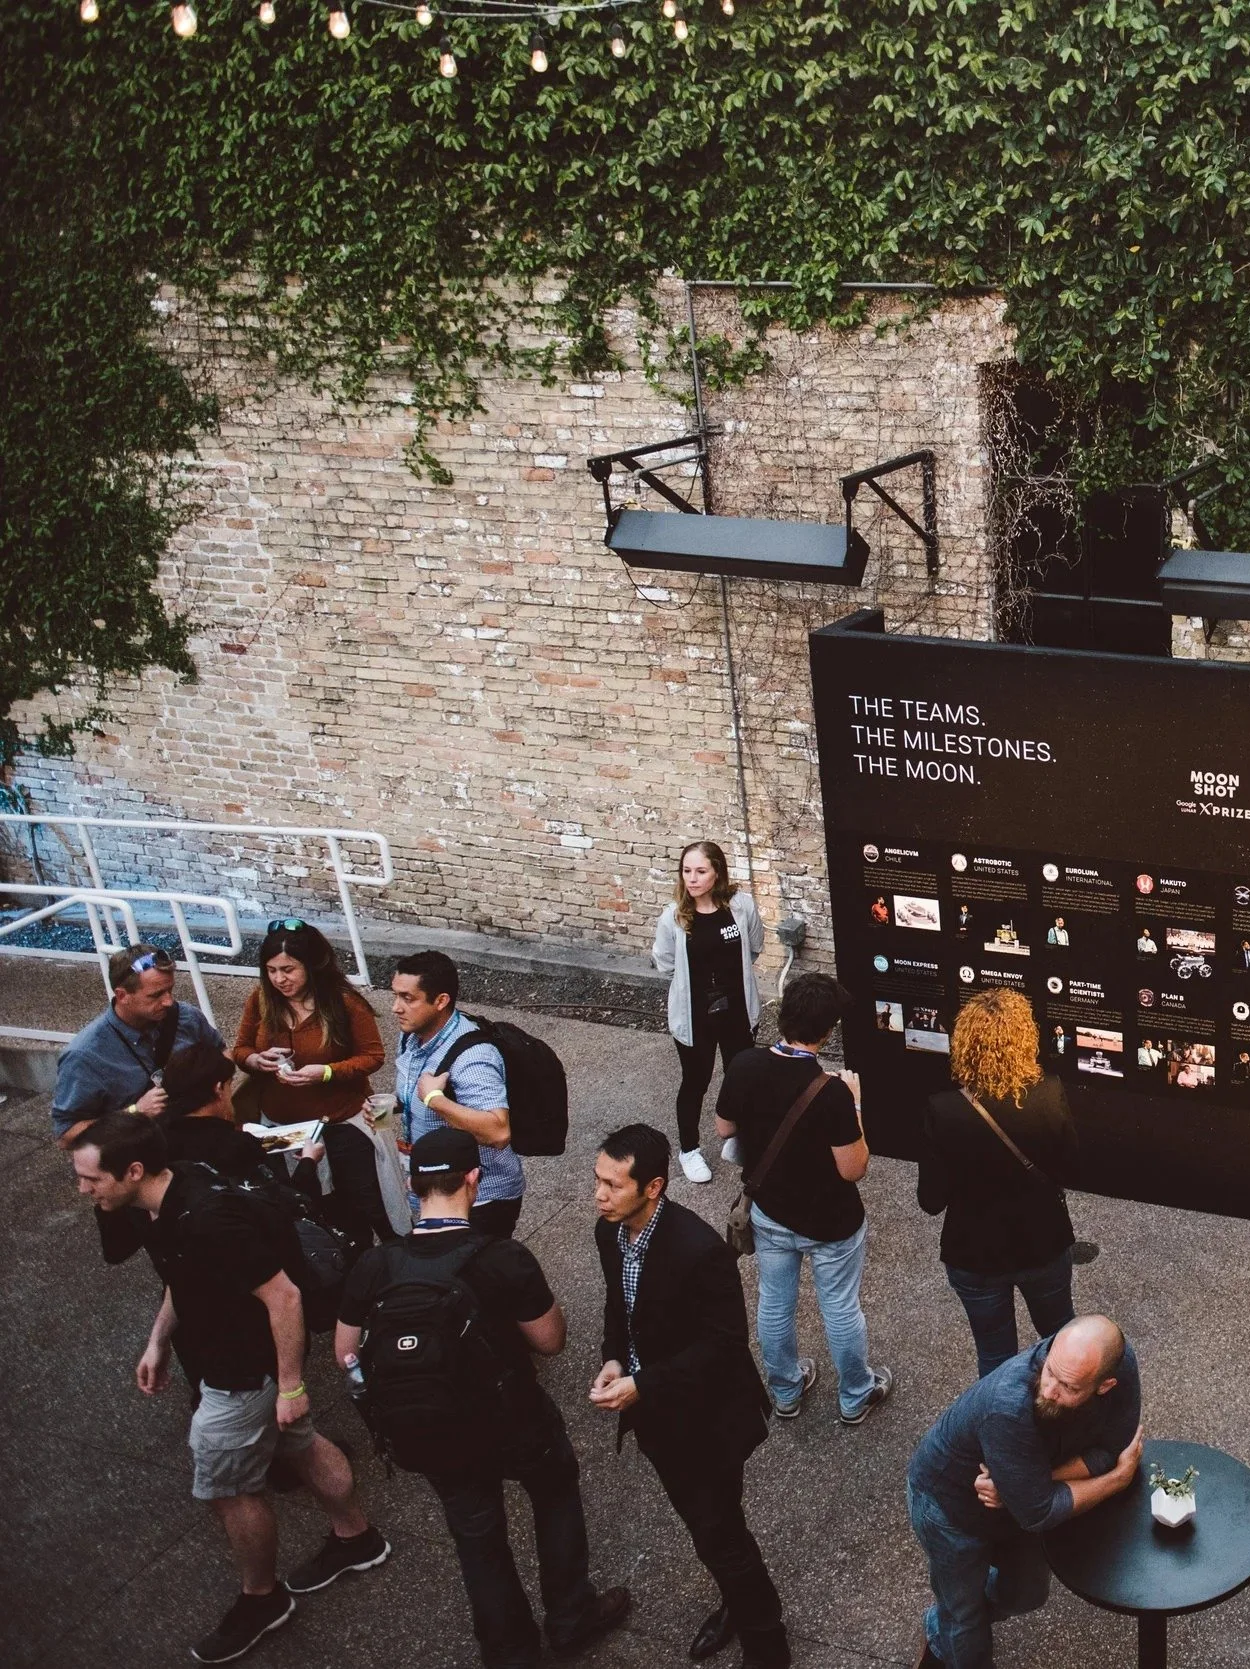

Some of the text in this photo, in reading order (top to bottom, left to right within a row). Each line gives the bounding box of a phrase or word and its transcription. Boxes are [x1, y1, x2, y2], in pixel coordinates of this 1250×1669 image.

[849, 696, 986, 726] THE TEAMS.
[852, 725, 1057, 763] THE MILESTONES.
[854, 754, 981, 784] THE MOON.
[1190, 770, 1240, 787] MOON
[1194, 783, 1236, 798] SHOT
[1176, 800, 1197, 808] Google
[884, 848, 919, 856] ANGELICVM
[974, 858, 1012, 866] ASTROBOTIC
[1065, 867, 1098, 876] EUROLUNA
[1066, 876, 1113, 886] INTERNATIONAL
[1160, 879, 1186, 887] HAKUTO
[720, 924, 738, 934] MOO
[724, 930, 739, 940] SHO
[912, 961, 938, 969] EXPRESS
[1069, 980, 1101, 990] PART-TIME
[1069, 988, 1104, 997] SCIENTISTS
[1070, 996, 1099, 1005] GERMANY
